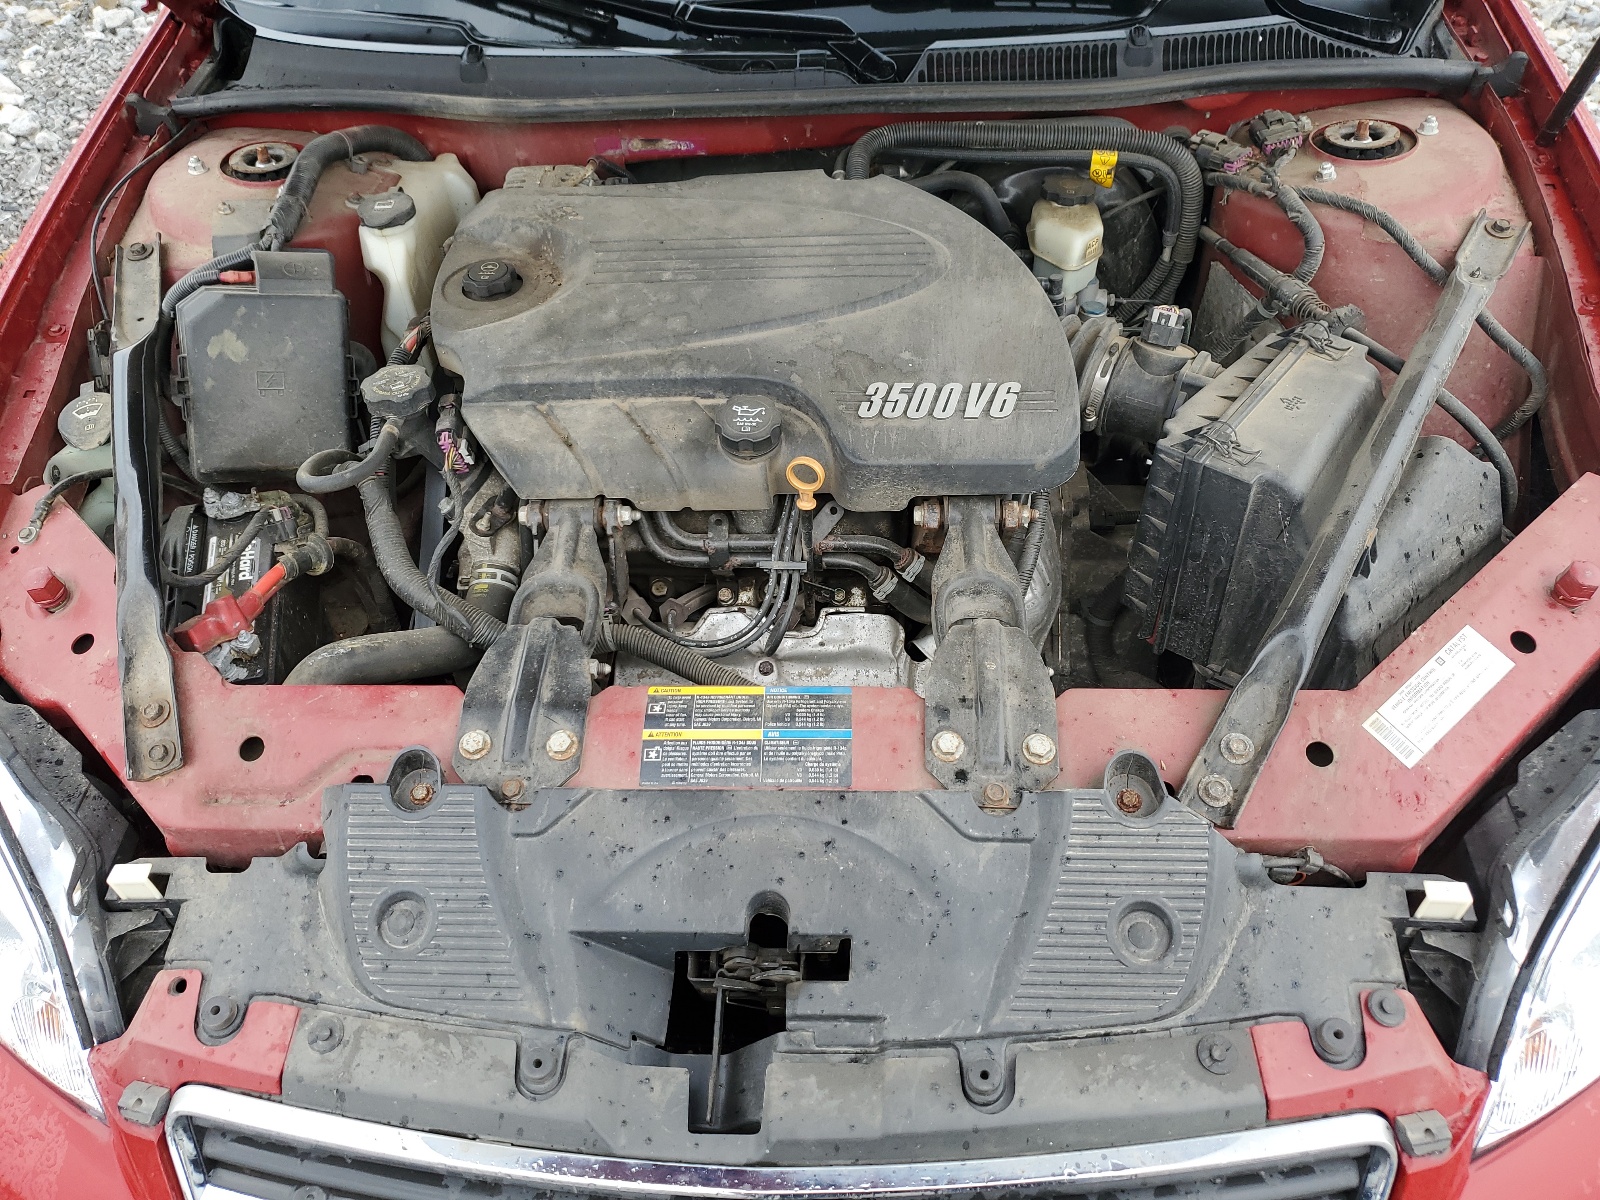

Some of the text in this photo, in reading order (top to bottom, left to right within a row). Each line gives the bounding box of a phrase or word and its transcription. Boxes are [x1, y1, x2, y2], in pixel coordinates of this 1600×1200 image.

[857, 382, 1022, 419] 3500 V6
[1444, 633, 1468, 655] CATALYST
